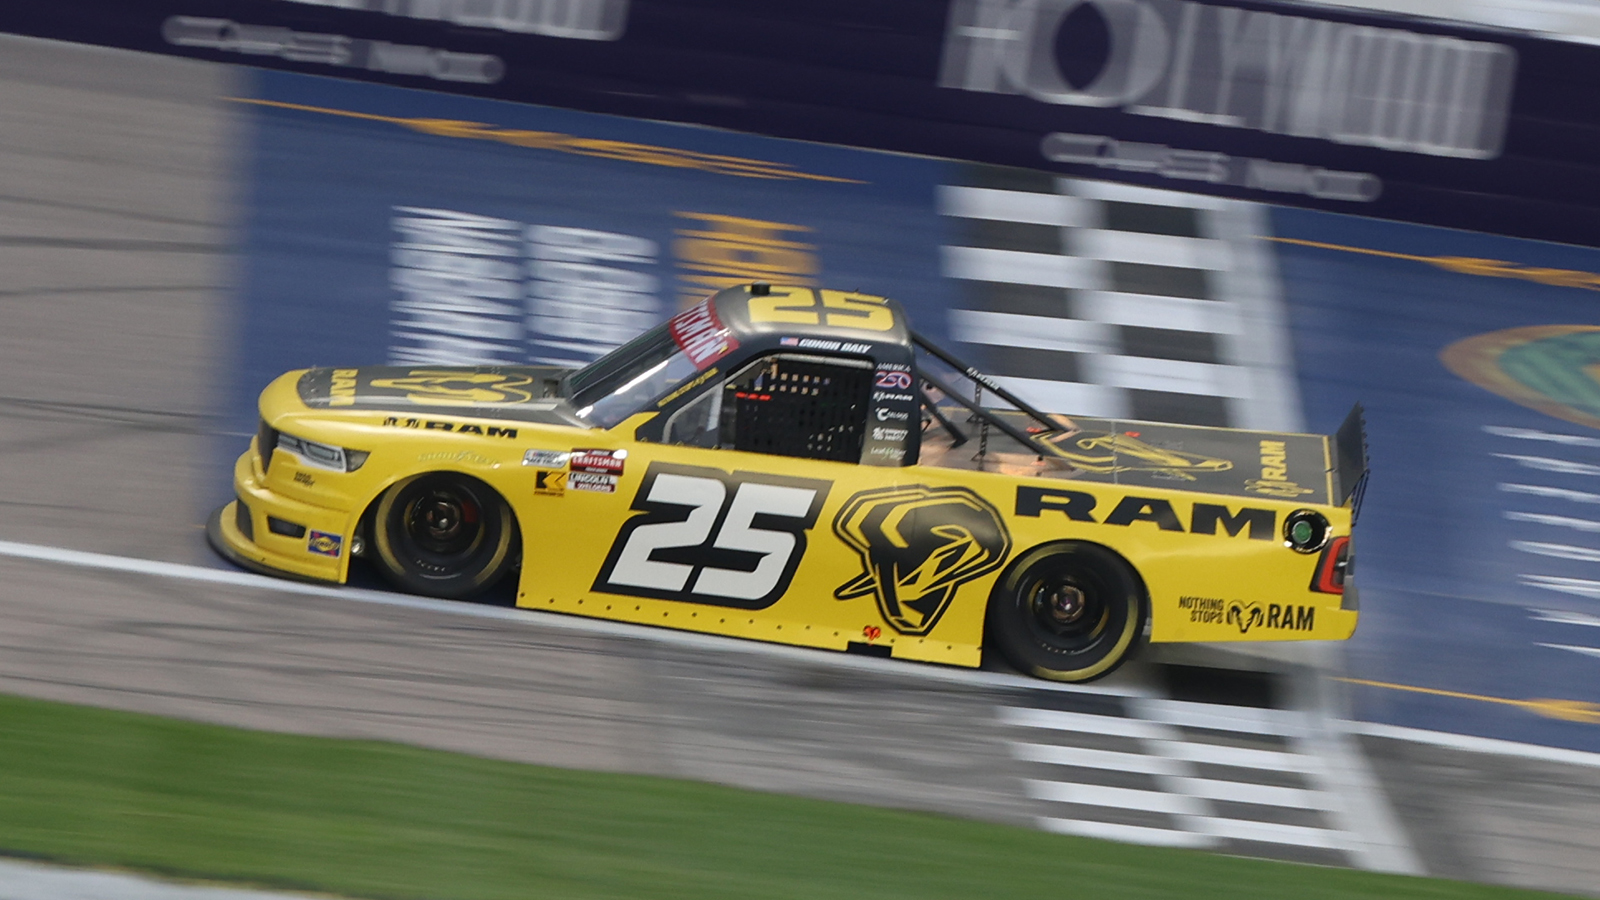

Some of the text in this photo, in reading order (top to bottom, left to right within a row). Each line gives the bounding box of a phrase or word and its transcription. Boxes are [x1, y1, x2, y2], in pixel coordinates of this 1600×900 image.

[744, 285, 894, 331] 25
[798, 339, 873, 354] CONOR DALY
[329, 369, 358, 407] RAM
[875, 370, 914, 390] 250
[425, 421, 518, 439] RAM
[572, 455, 622, 468] CRAFTSMAN
[1259, 440, 1287, 481] RAM
[570, 472, 610, 485] LINCOLN
[1014, 485, 1277, 541] RAM
[607, 473, 817, 600] 25
[1178, 596, 1225, 613] NOTHING
[1190, 604, 1315, 631] STOPS RAM
